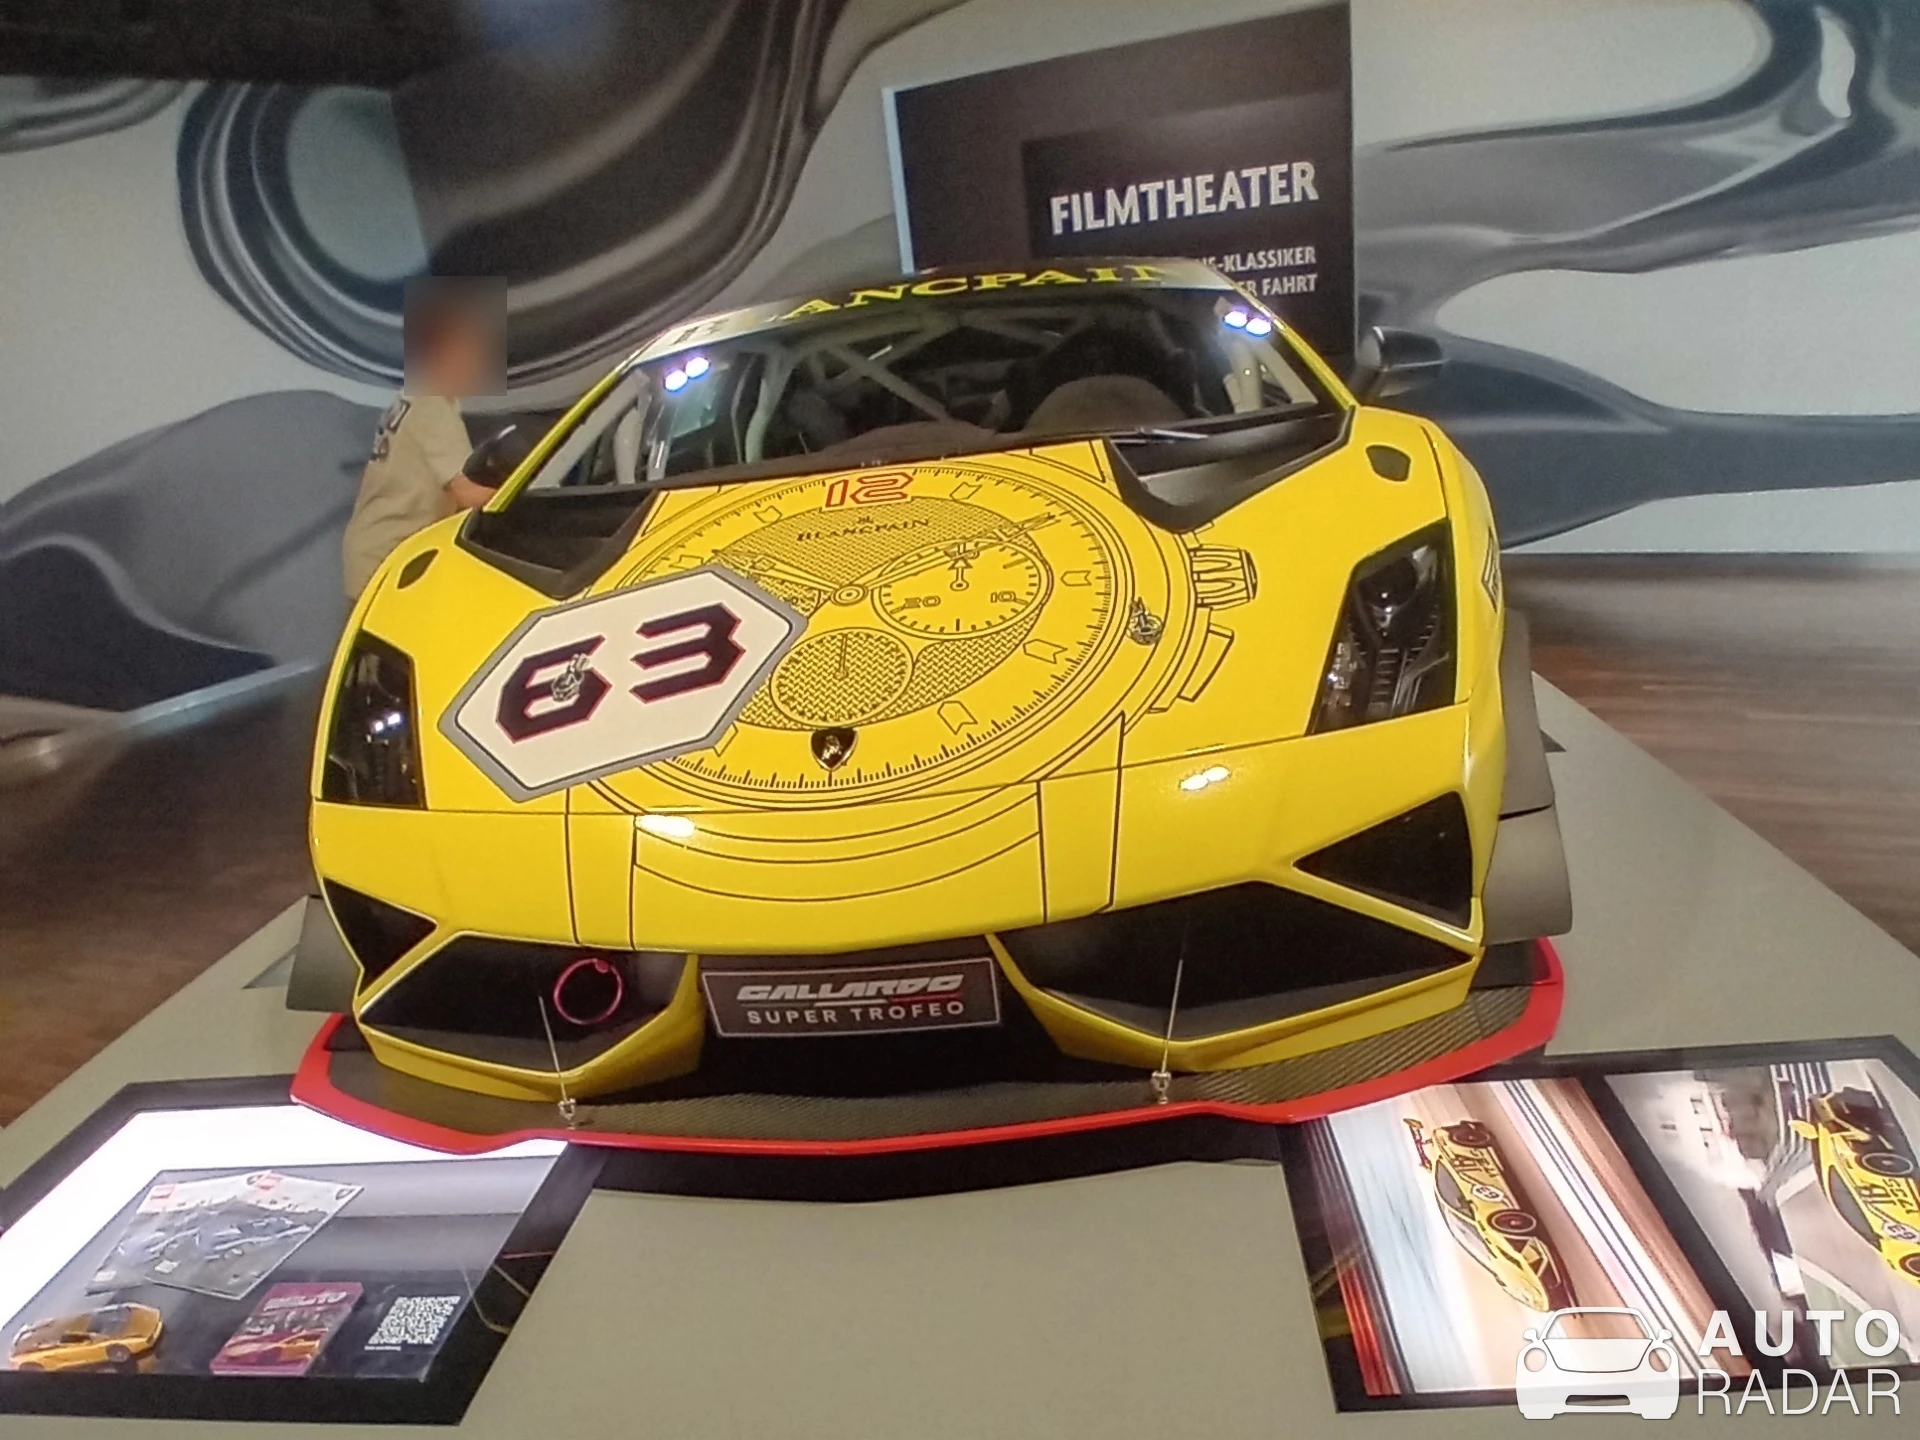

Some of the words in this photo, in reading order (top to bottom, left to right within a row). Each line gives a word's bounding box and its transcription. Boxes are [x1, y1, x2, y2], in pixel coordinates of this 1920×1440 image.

[1050, 161, 1319, 235] FILMTHEATER
[1262, 273, 1318, 296] FAHRT
[825, 472, 914, 508] 12
[990, 591, 1016, 603] 10
[495, 602, 747, 744] 63
[736, 974, 965, 1001] GALLARDO
[747, 1009, 838, 1025] SUPER
[850, 1001, 965, 1022] TROFEO
